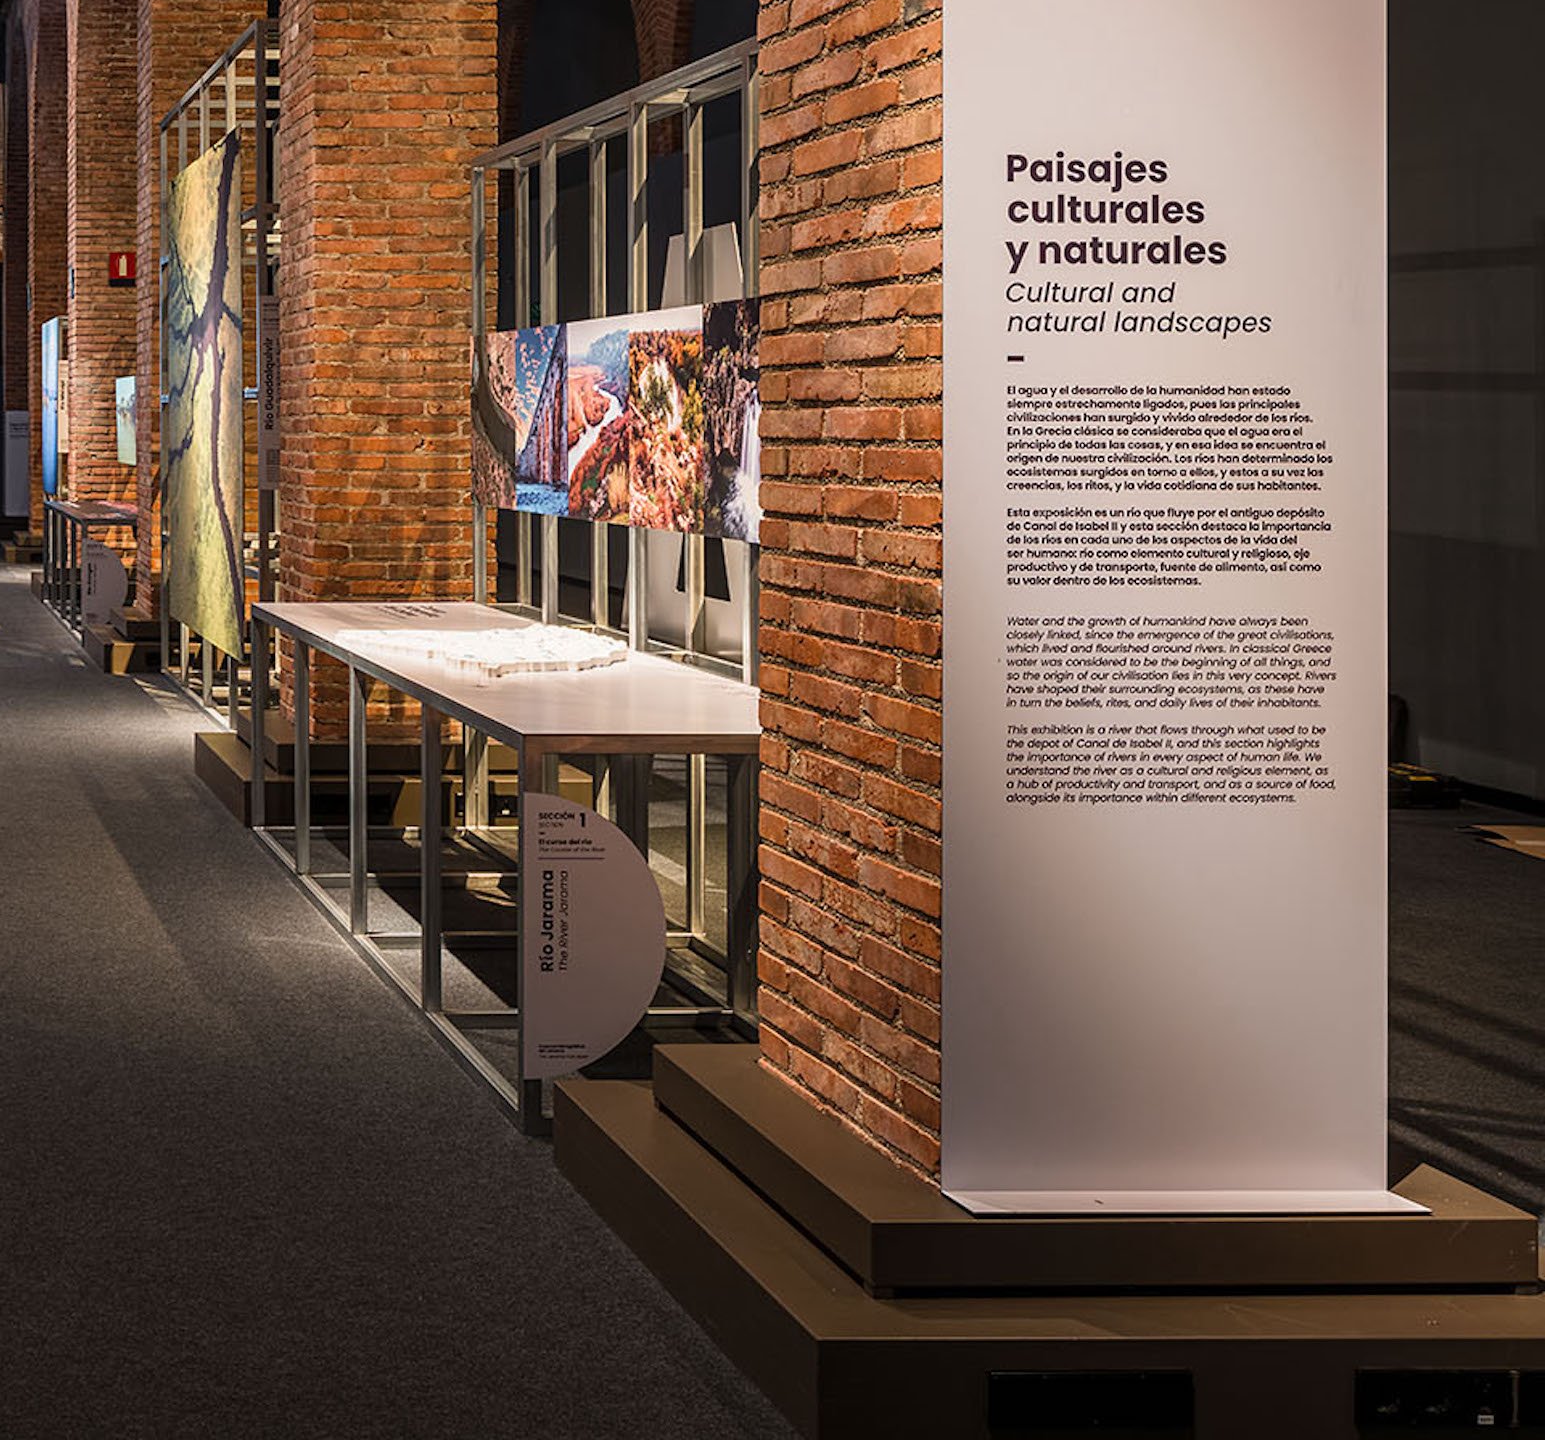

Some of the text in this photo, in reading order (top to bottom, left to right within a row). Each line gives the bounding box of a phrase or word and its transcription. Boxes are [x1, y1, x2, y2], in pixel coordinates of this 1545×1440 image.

[1007, 151, 1167, 193] Paisajes
[1008, 195, 1204, 223] culturales
[1005, 235, 1226, 274] y naturales
[1005, 282, 1175, 303] Cultural and
[1008, 311, 1271, 339] natural landscapes
[264, 338, 274, 411] Guadalquivir
[1007, 386, 1016, 395] El
[1017, 388, 1048, 398] agua
[1059, 386, 1069, 395] el
[1071, 386, 1128, 395] desarrollo
[1130, 386, 1145, 395] de
[1146, 386, 1157, 395] la
[1159, 386, 1225, 395] humanidad
[1227, 386, 1250, 395] han
[1252, 386, 1291, 395] estado
[1007, 399, 1301, 411] siempre estrechamente ligados, pues las principales
[265, 414, 274, 430] Río
[1006, 413, 1082, 422] civilizaciones
[1083, 413, 1106, 422] han
[1107, 413, 1151, 425] surgido
[1162, 413, 1196, 422] vivido
[1197, 413, 1253, 422] alrededor
[1254, 413, 1270, 422] de
[1271, 413, 1288, 422] los
[1289, 413, 1313, 422] ríos.
[1007, 508, 1030, 517] Esta
[1032, 508, 1093, 520] exposición
[1126, 508, 1142, 517] río
[1143, 510, 1166, 520] que
[1167, 508, 1195, 520] fluye
[1197, 510, 1217, 520] por
[1218, 508, 1229, 517] el
[1230, 508, 1275, 520] antiguo
[1276, 508, 1325, 520] depósito
[1007, 550, 1025, 558] ser
[1026, 548, 1077, 558] humano:
[1079, 548, 1095, 558] río
[1096, 550, 1129, 558] como
[1130, 548, 1185, 558] elemento
[1186, 548, 1230, 558] cultural
[1241, 548, 1292, 560] religioso,
[1293, 548, 1311, 560] eje
[1006, 616, 1309, 628] Water and the growth of humankind have always been
[1005, 643, 1332, 653] which lived and flourished around rivers. In classical Greece
[1005, 792, 1296, 804] alongside its importance within different ecosystems.
[579, 812, 586, 827] 1
[540, 870, 554, 972] Río Jarama
[558, 871, 569, 972] The River Jarama
